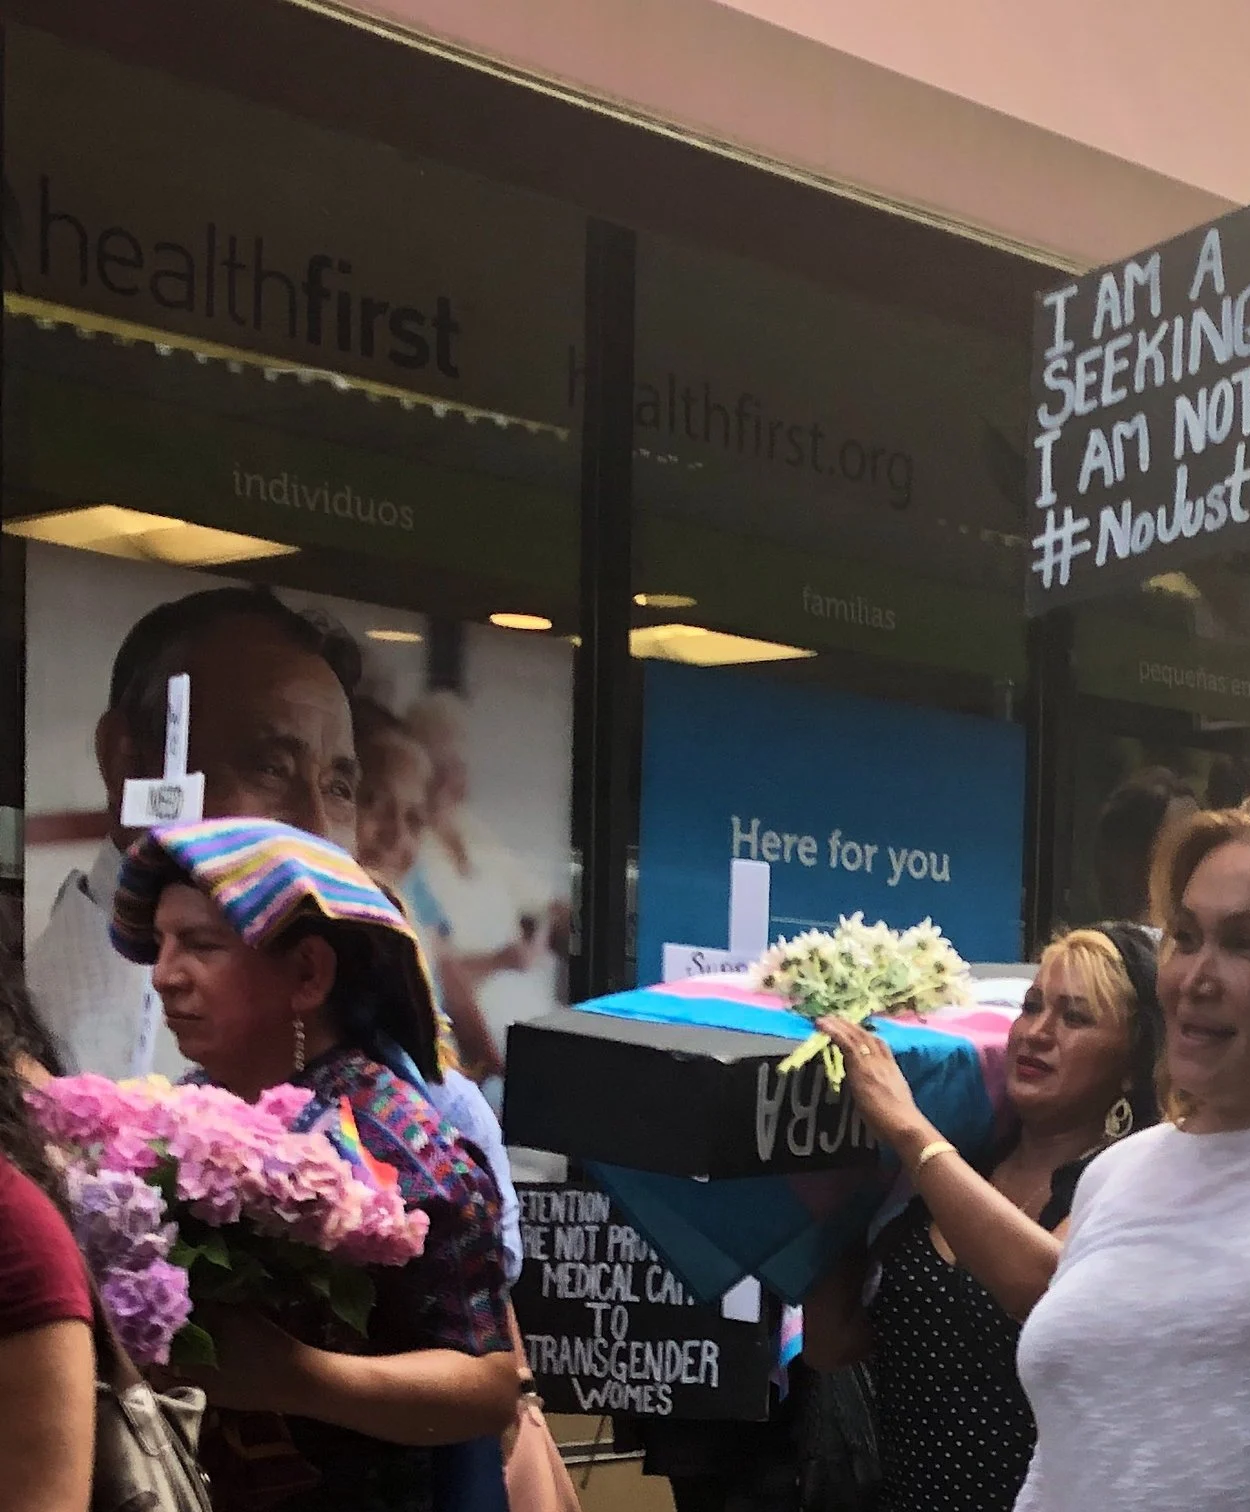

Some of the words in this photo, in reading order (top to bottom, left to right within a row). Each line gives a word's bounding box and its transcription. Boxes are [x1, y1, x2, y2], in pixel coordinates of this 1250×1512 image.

[39, 173, 460, 378] healthfirst
[1044, 285, 1078, 358] I
[1093, 253, 1160, 338] AM
[1190, 228, 1225, 299] A
[568, 344, 914, 510] halthfirst.org
[1035, 428, 1060, 507] I
[1078, 414, 1149, 493] AM
[233, 463, 416, 532] individuos
[802, 582, 897, 632] familias
[731, 815, 818, 868] Here
[828, 829, 879, 874] for
[887, 847, 952, 887] you
[519, 1190, 611, 1224] ETENTION
[553, 1225, 600, 1262] NOT
[542, 1262, 640, 1302] MEDICAL
[585, 1302, 629, 1341] TO
[526, 1334, 719, 1388] TRANSGENDER
